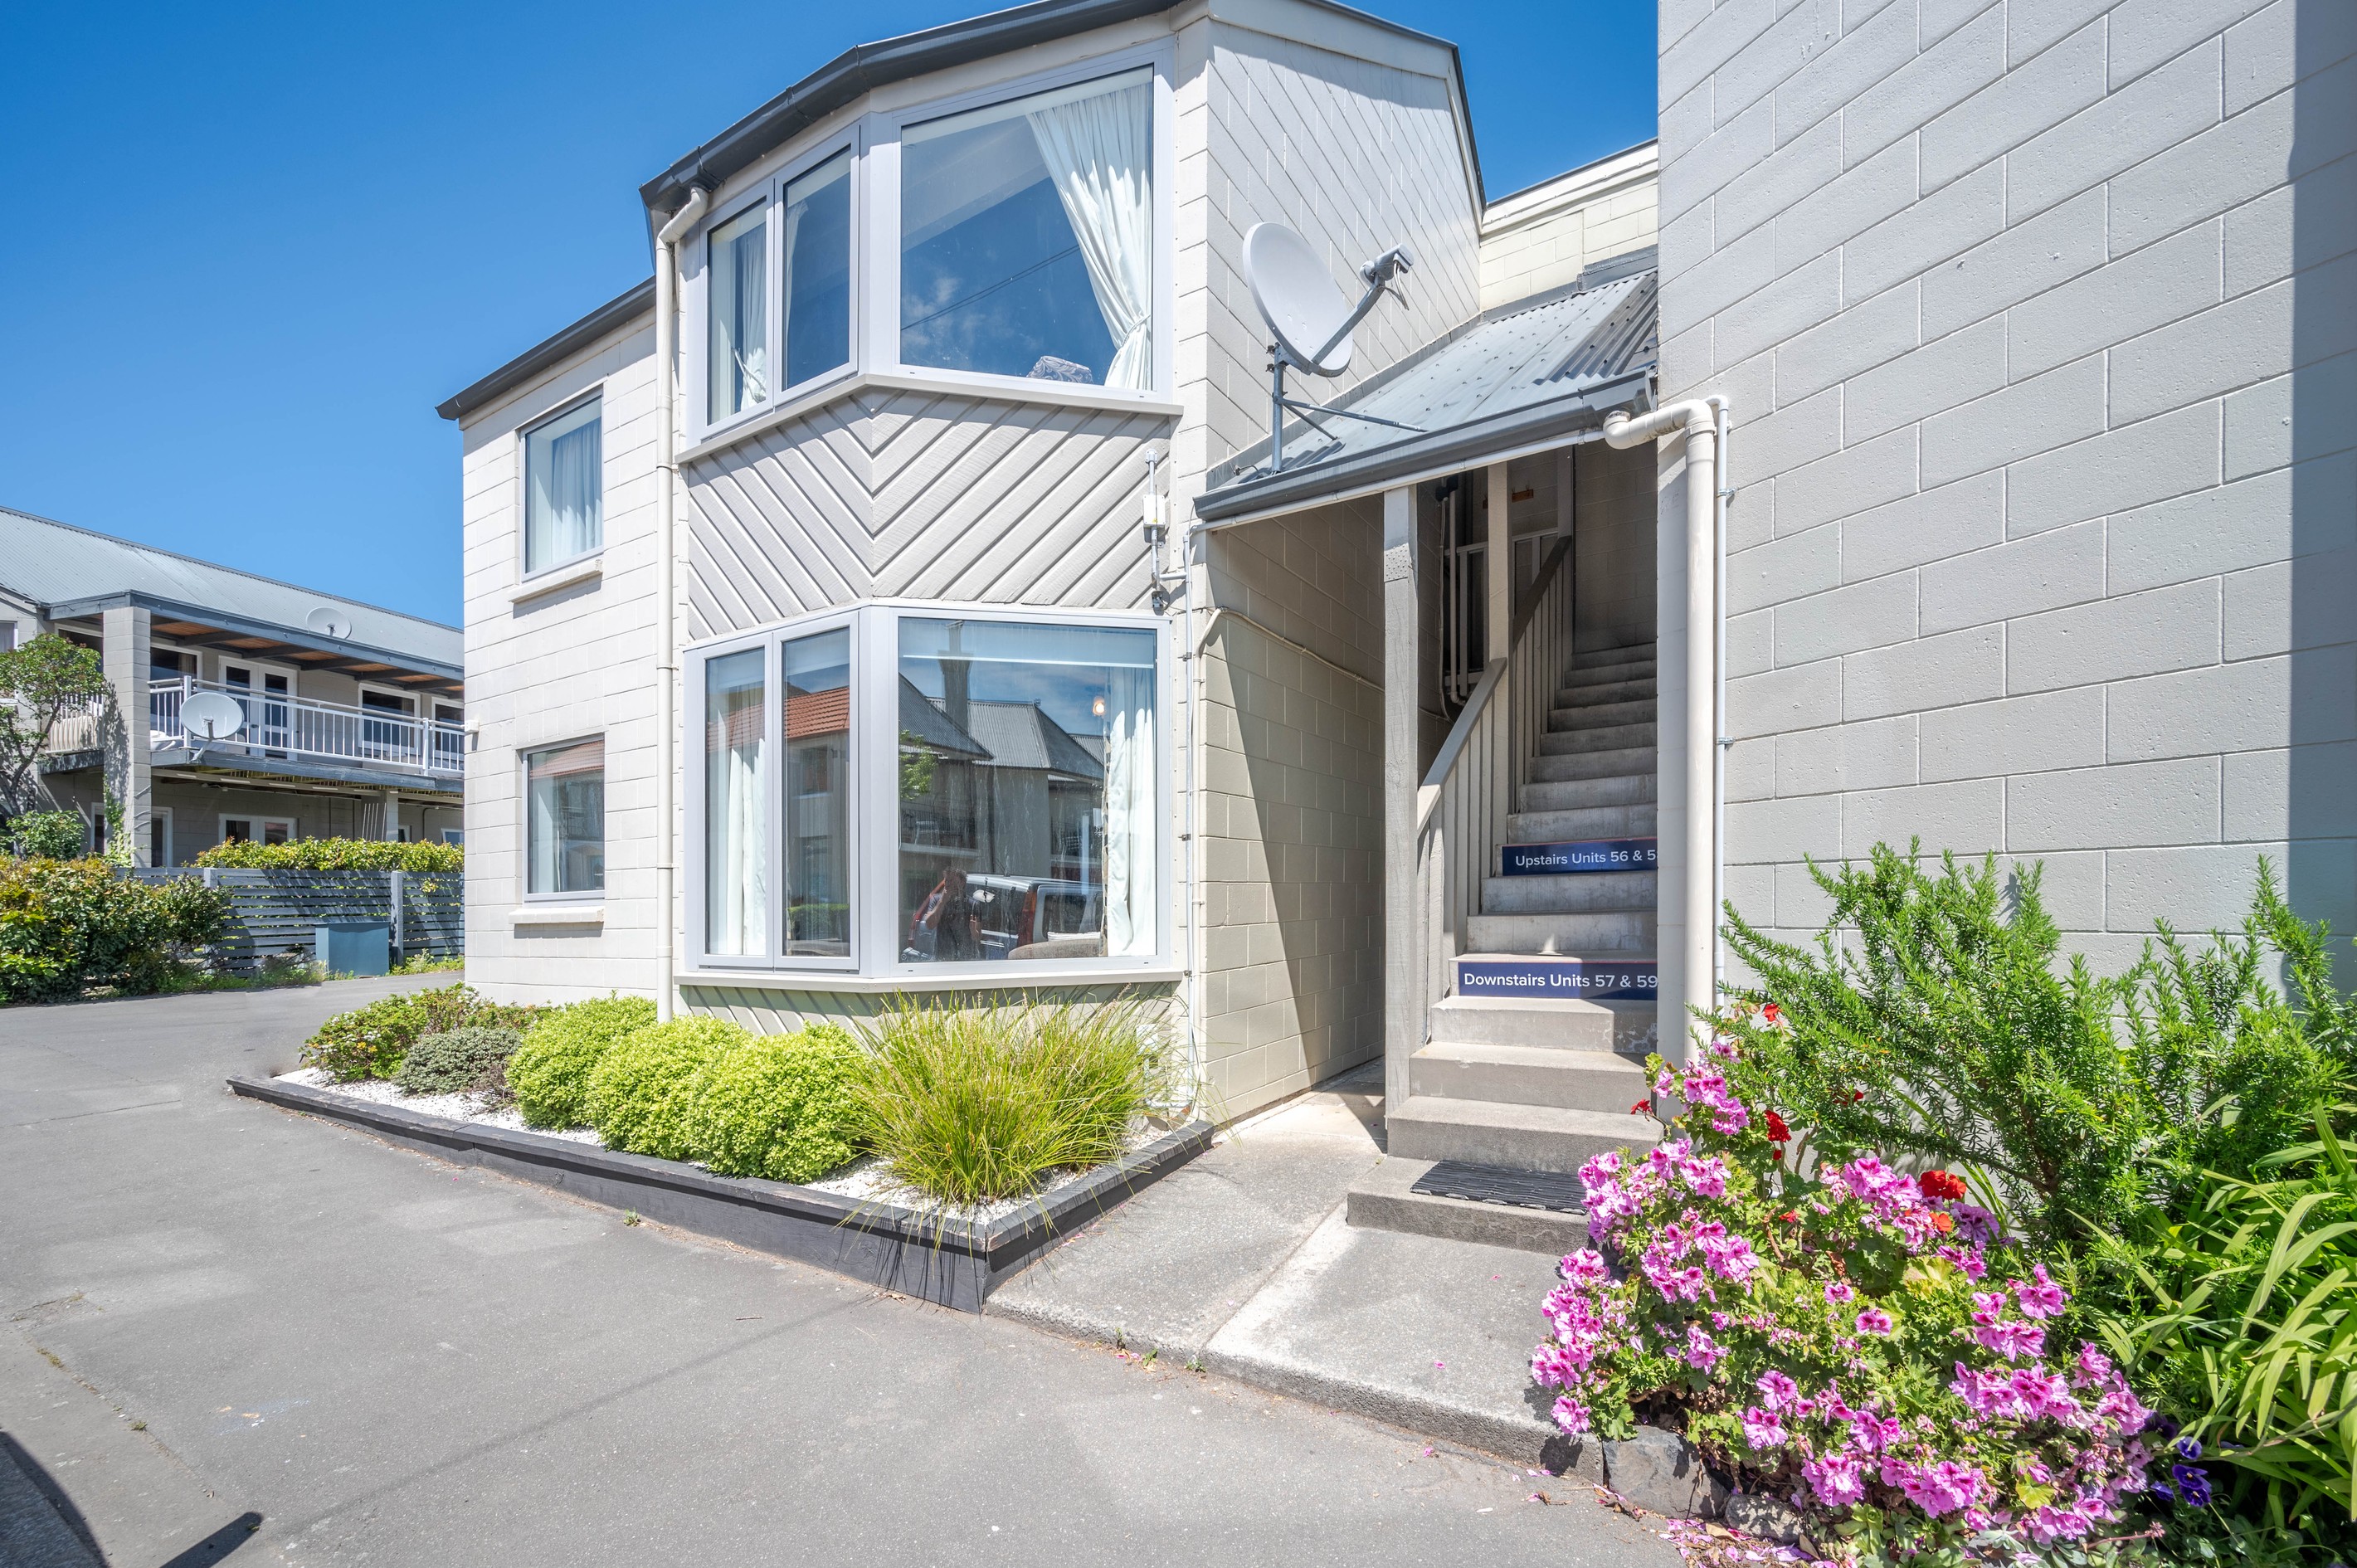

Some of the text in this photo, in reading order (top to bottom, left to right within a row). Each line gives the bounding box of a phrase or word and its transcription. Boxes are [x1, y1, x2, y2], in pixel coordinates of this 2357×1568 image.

[1515, 849, 1658, 869] Upstairs Units 56 & 5
[1463, 972, 1658, 988] Downstairs Units 57 & 59
